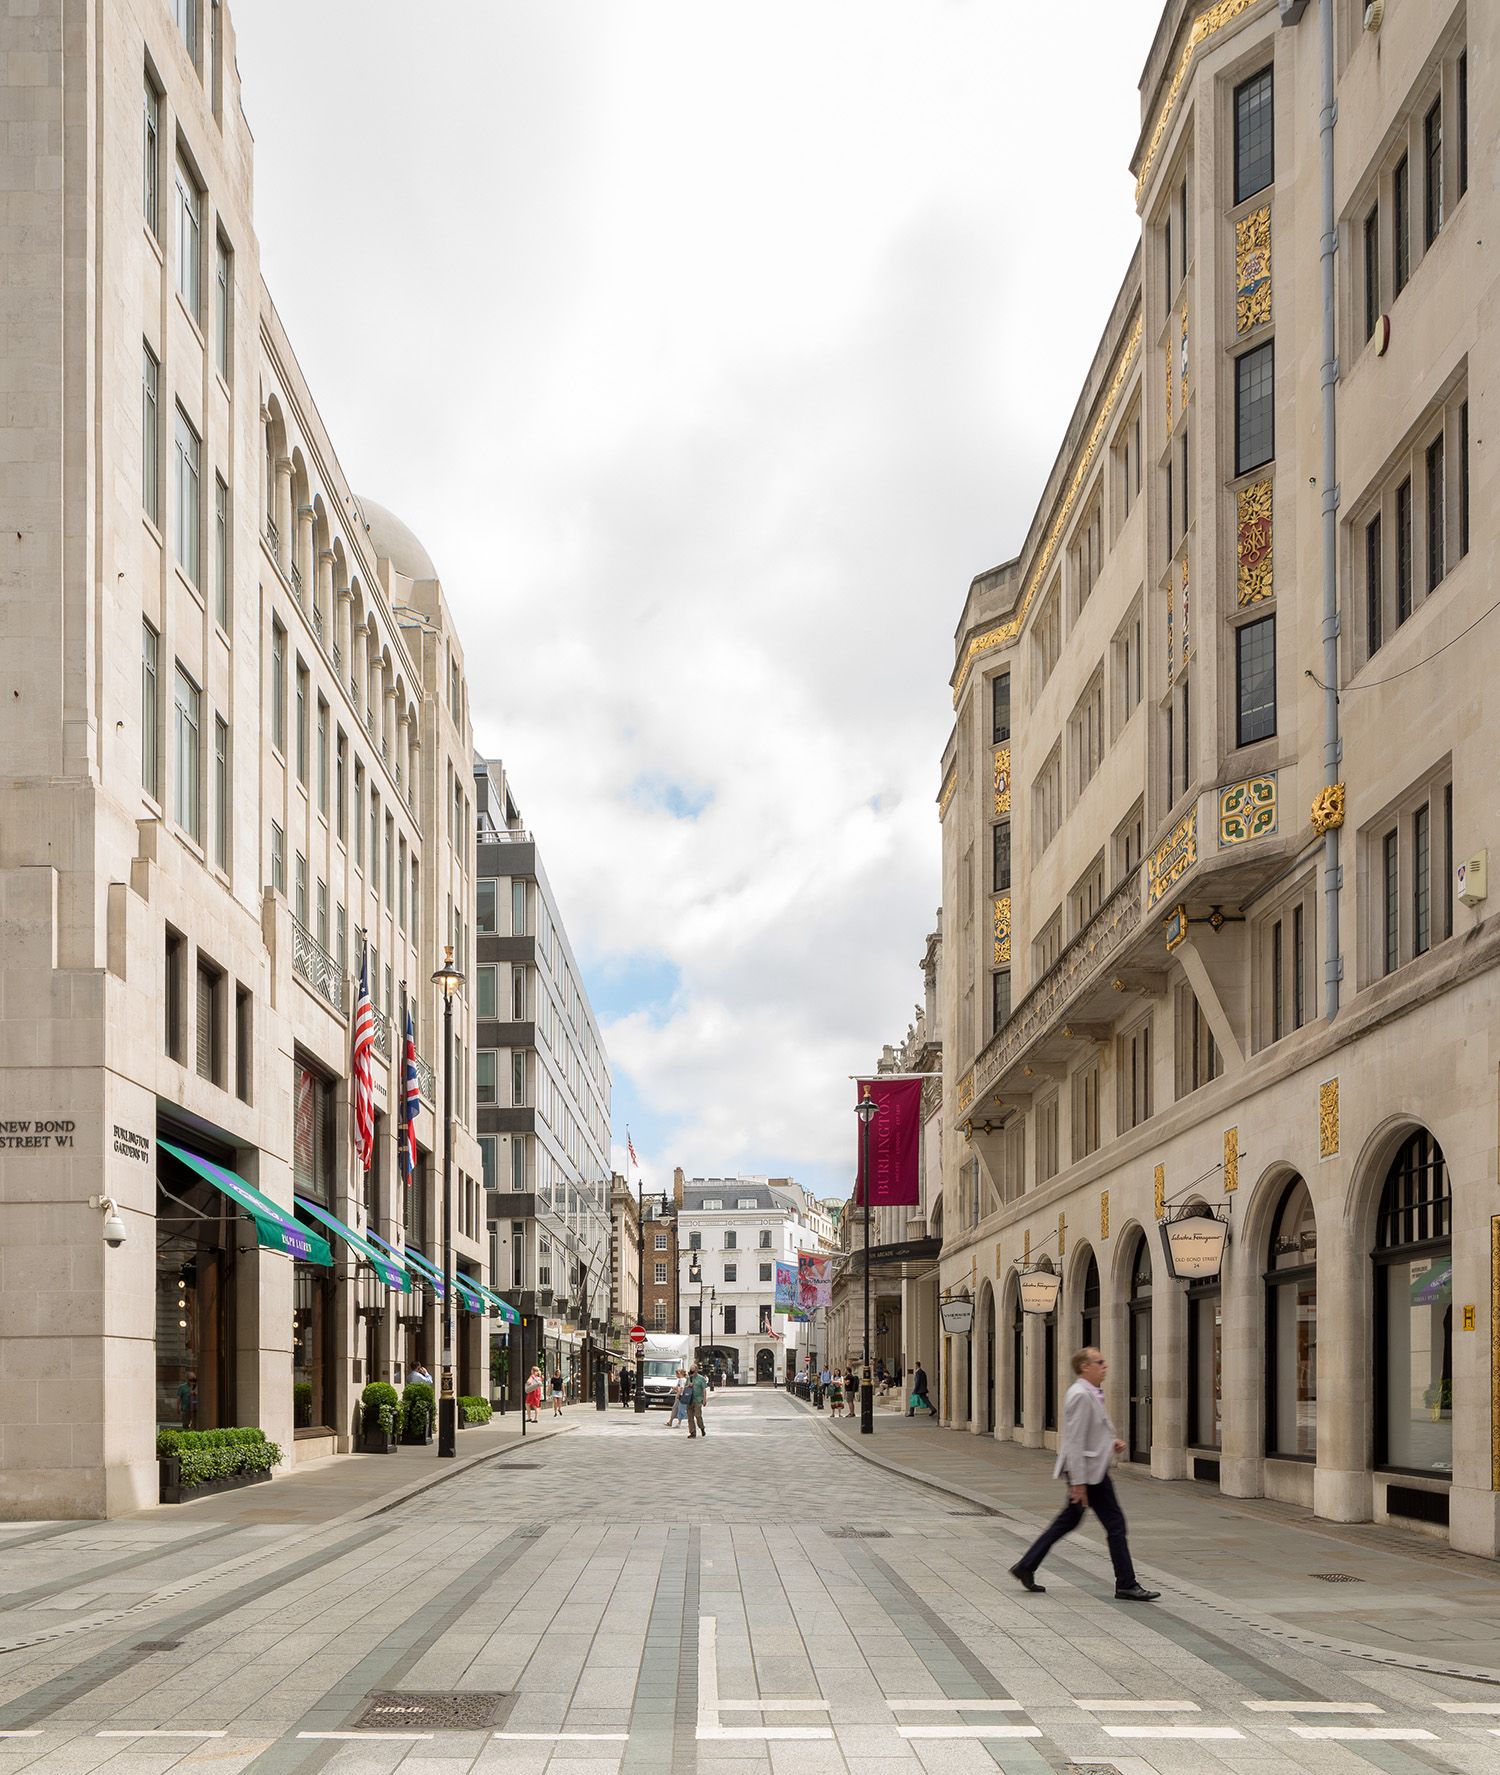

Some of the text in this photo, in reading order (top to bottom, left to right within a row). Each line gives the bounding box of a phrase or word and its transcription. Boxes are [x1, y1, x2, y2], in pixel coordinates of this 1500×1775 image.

[0, 1120, 75, 1133] NEW BOND
[0, 1135, 74, 1149] STREET W1
[113, 1125, 150, 1150] BURLINGTON
[878, 1093, 890, 1195] BURLINGTON
[113, 1140, 149, 1164] GARDENS W1
[281, 1233, 312, 1252] RALPH LAUREN
